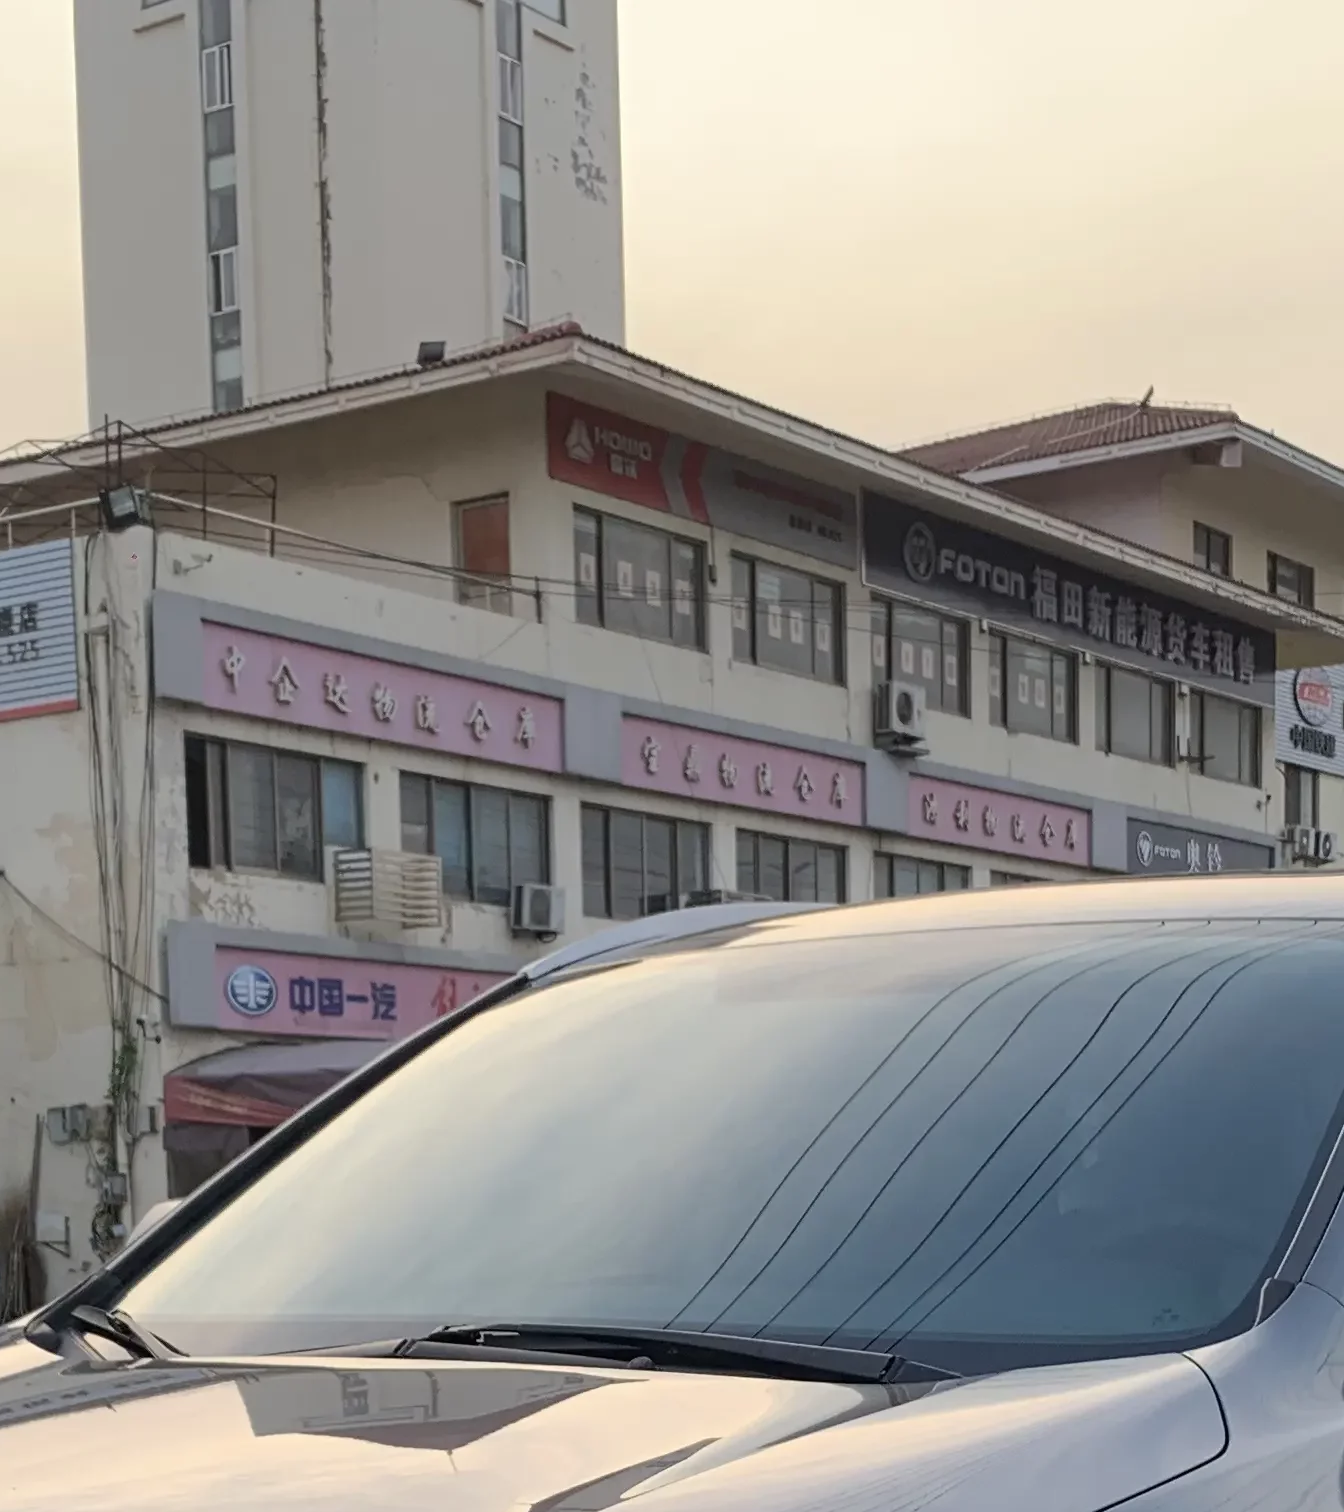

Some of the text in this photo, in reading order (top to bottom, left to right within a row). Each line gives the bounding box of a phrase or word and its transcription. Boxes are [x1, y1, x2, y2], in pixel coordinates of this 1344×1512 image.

[939, 548, 1026, 600] FOTON
[222, 644, 536, 750] 中企达物流仓库
[289, 976, 397, 1021] 中国一汽
